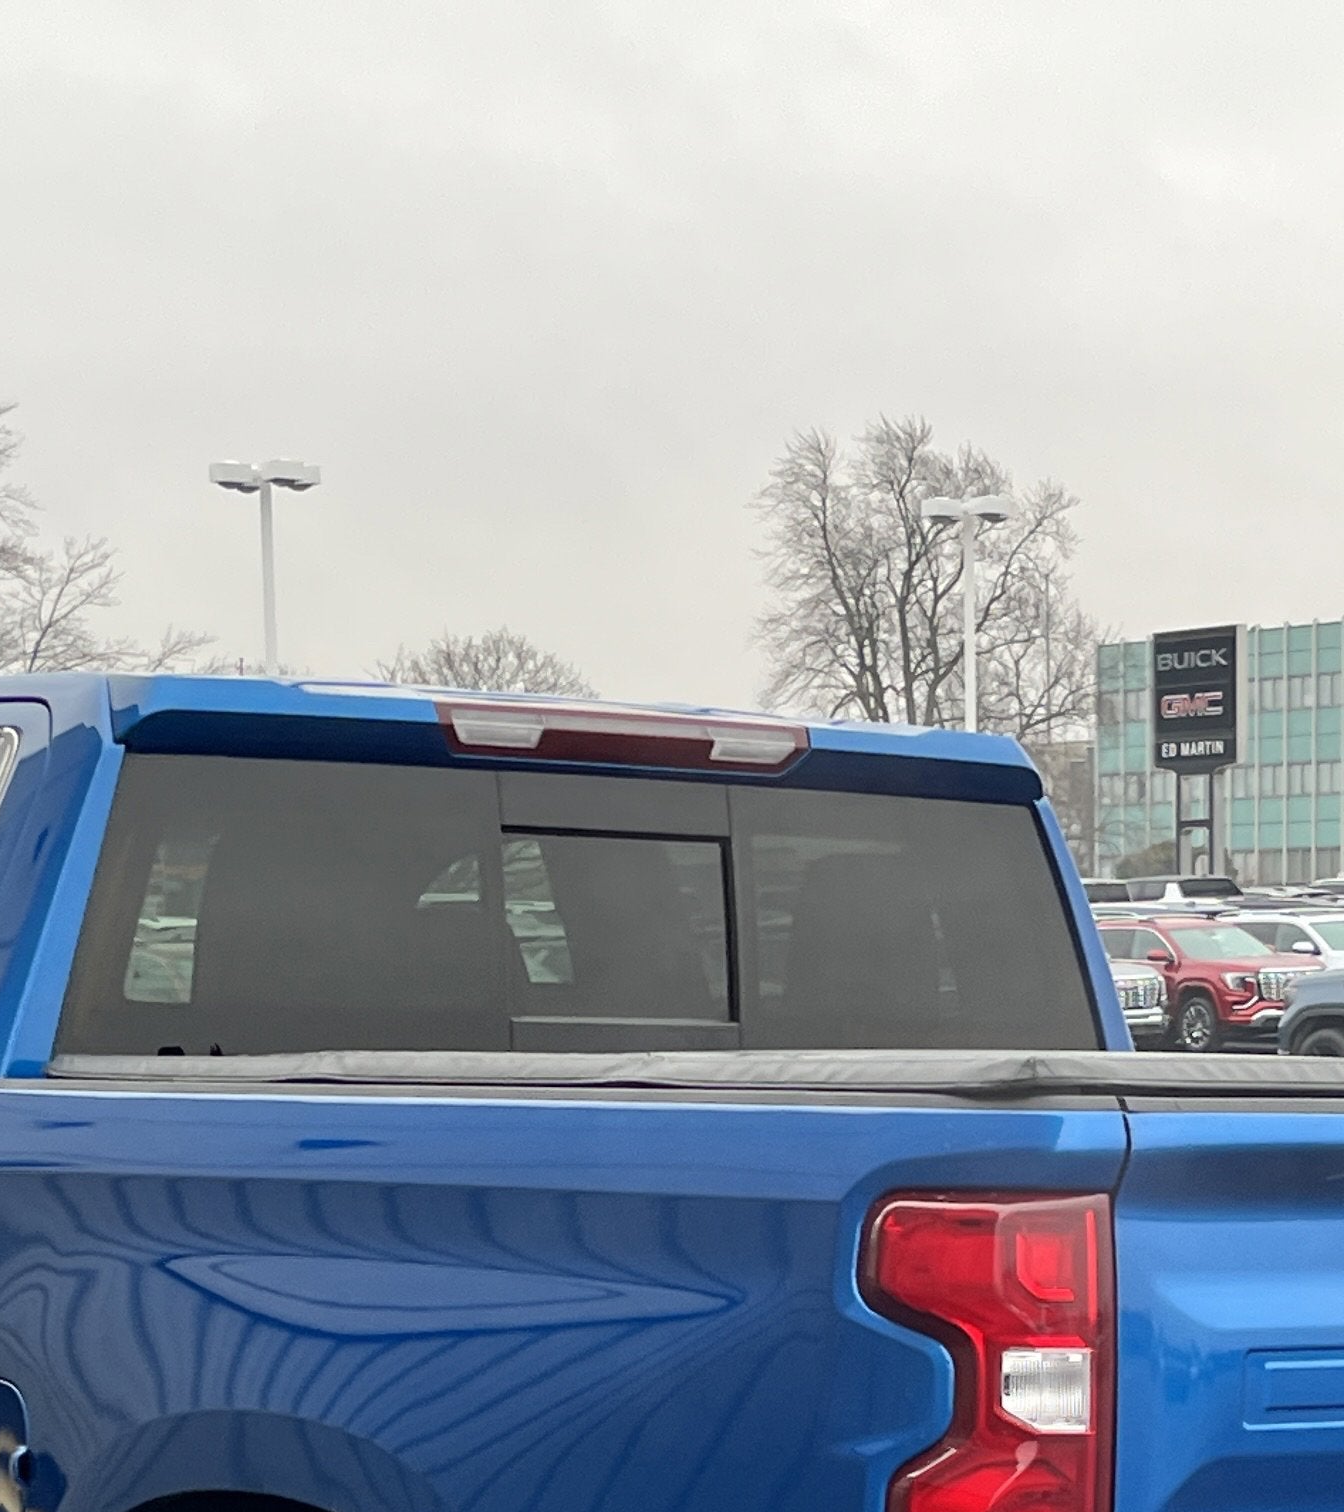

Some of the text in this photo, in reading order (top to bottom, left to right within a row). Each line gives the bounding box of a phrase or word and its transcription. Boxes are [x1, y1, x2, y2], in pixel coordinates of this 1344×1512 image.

[1156, 648, 1228, 671] BUICK
[1160, 691, 1223, 719] GMC
[1161, 740, 1224, 758] ED MARTIN
